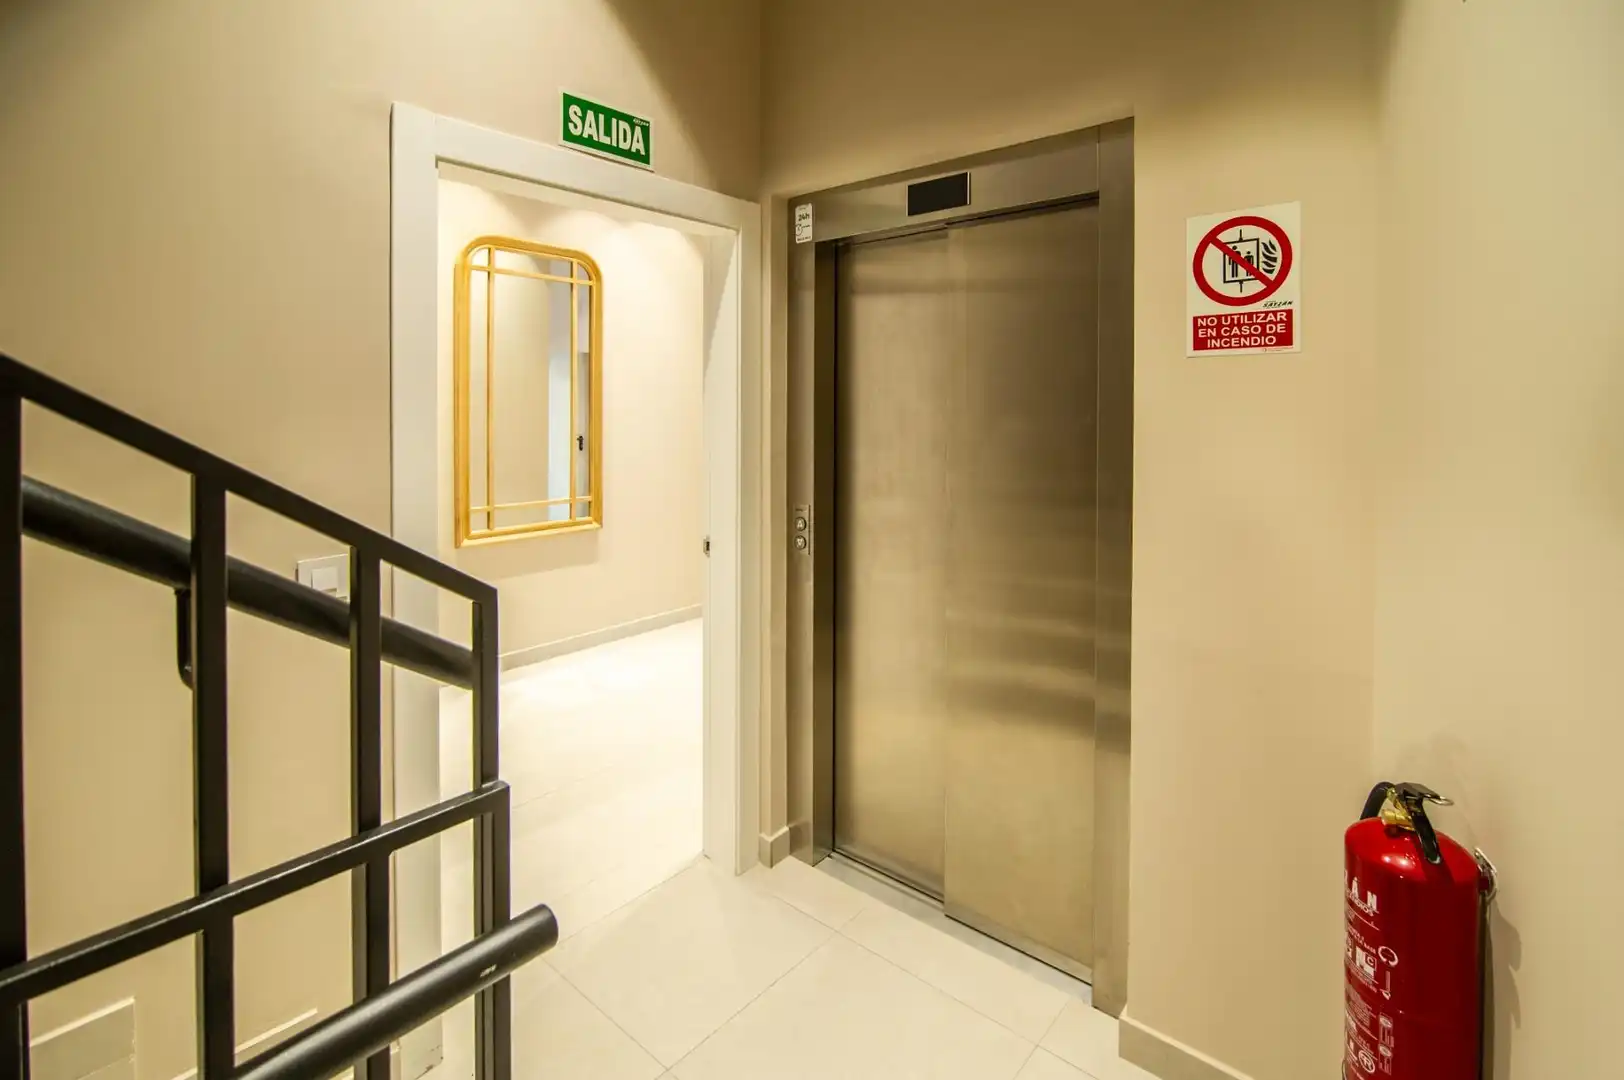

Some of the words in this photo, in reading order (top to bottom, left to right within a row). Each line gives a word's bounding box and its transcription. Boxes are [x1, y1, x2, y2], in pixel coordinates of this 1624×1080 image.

[568, 104, 646, 156] SALIDA
[1197, 316, 1218, 327] NO
[1221, 311, 1287, 326] UTILIZAR
[1198, 327, 1217, 338] EN
[1220, 324, 1262, 337] CASO
[1266, 322, 1287, 334] DE
[1207, 335, 1277, 348] INCENDIO
